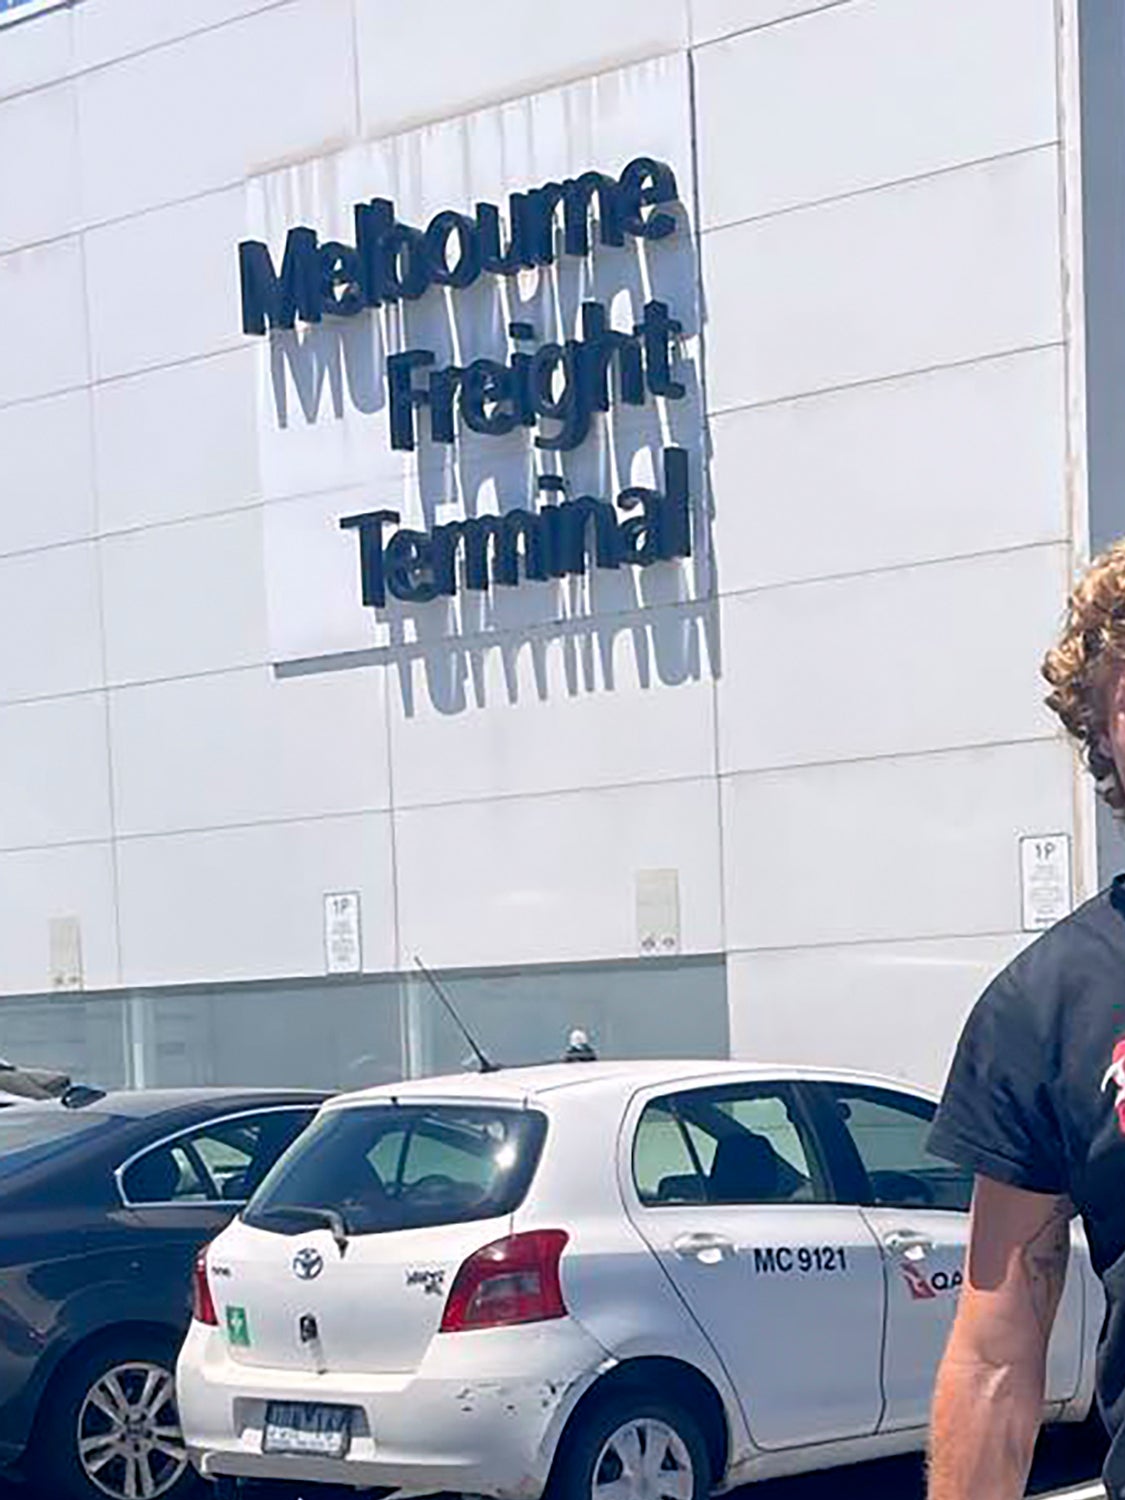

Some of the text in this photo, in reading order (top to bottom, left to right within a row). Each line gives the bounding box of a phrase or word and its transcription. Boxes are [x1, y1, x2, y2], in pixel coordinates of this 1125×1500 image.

[239, 157, 678, 336] Melbourne
[387, 299, 687, 453] Freight
[340, 446, 691, 609] Terminal
[1035, 842, 1056, 861] 1P
[754, 1246, 847, 1273] MC 9121
